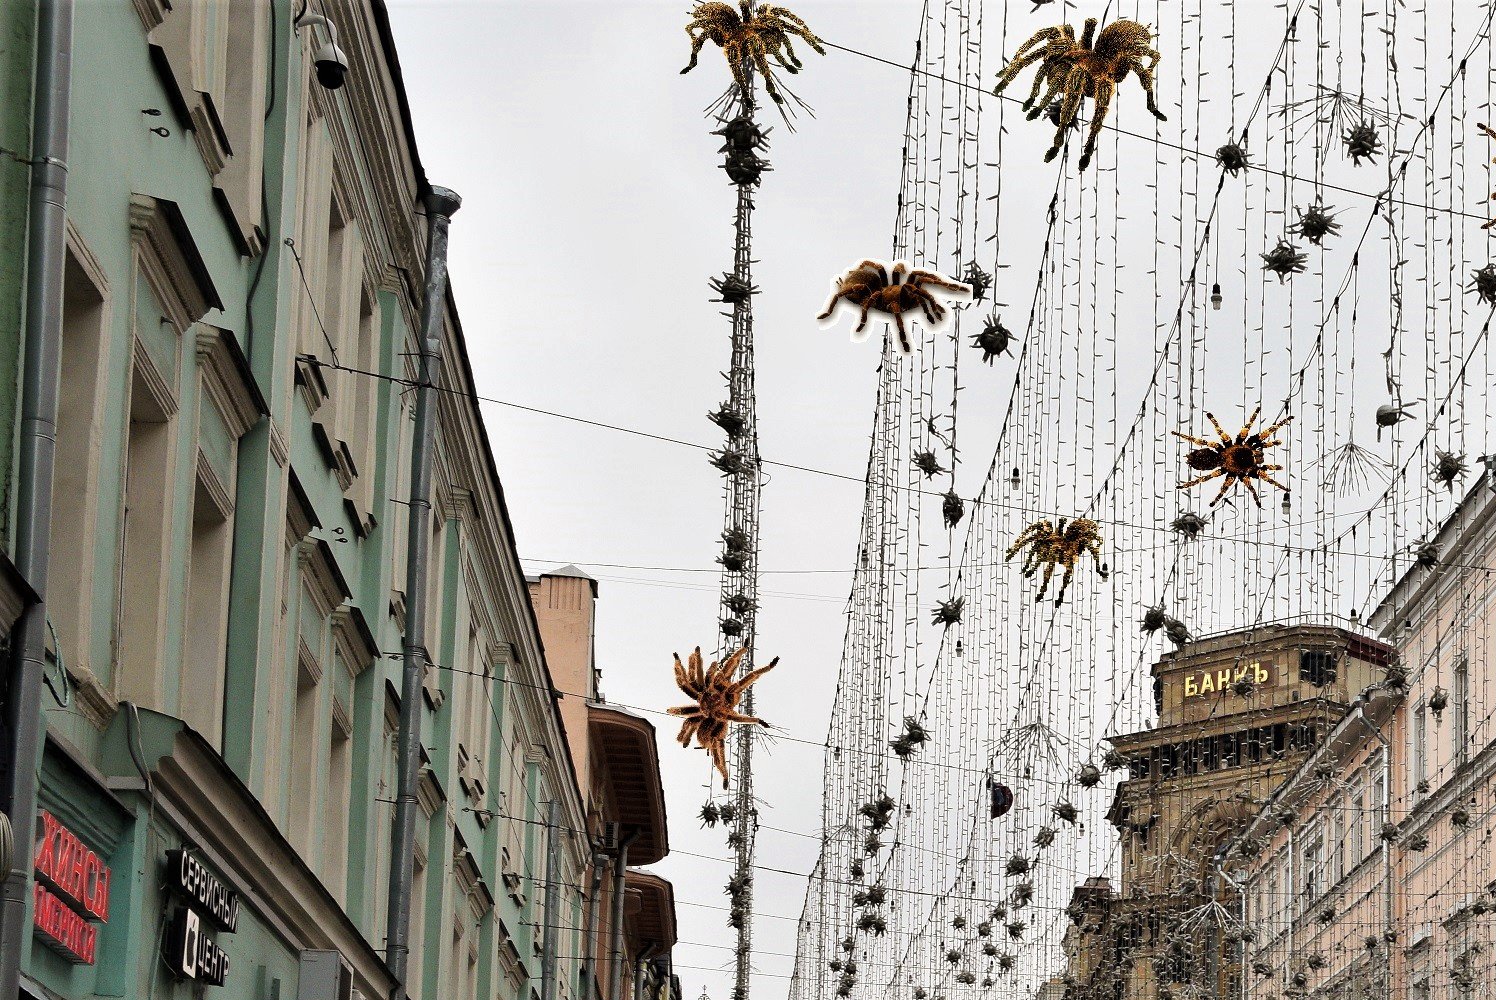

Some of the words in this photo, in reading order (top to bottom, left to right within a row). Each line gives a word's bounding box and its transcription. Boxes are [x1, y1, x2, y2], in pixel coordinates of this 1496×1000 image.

[1185, 663, 1269, 697] БАНКЪ
[181, 850, 240, 934] СЕРВИСНЫЙ
[198, 931, 230, 982] ЦЕНТР
